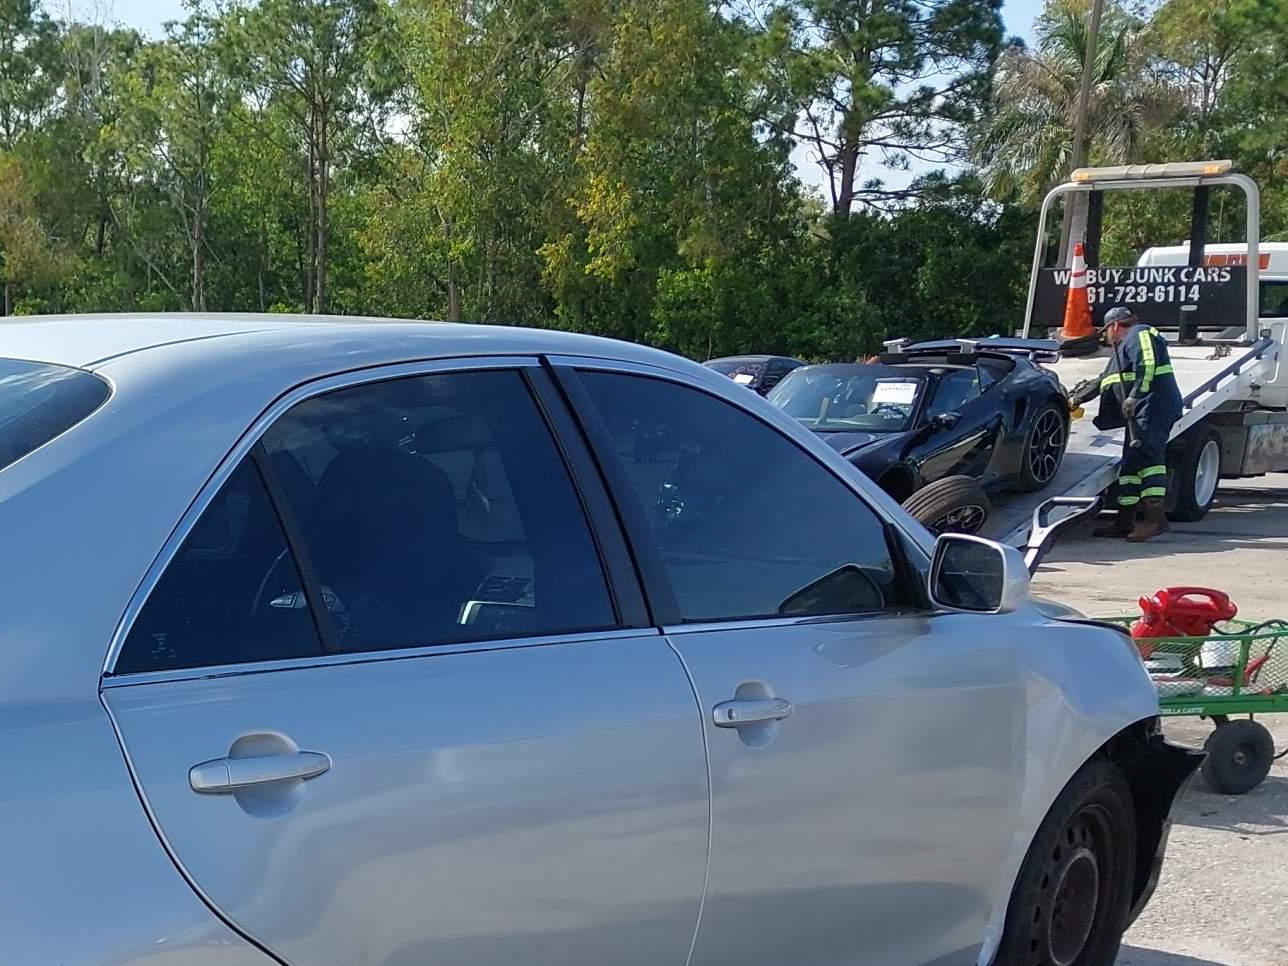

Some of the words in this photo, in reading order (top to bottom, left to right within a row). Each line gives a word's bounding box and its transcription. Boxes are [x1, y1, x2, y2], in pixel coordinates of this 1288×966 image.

[1086, 268, 1125, 285] BUY
[1125, 267, 1176, 284] JUNK
[1180, 266, 1231, 283] CARS
[1087, 285, 1200, 303] 61-723-6114
